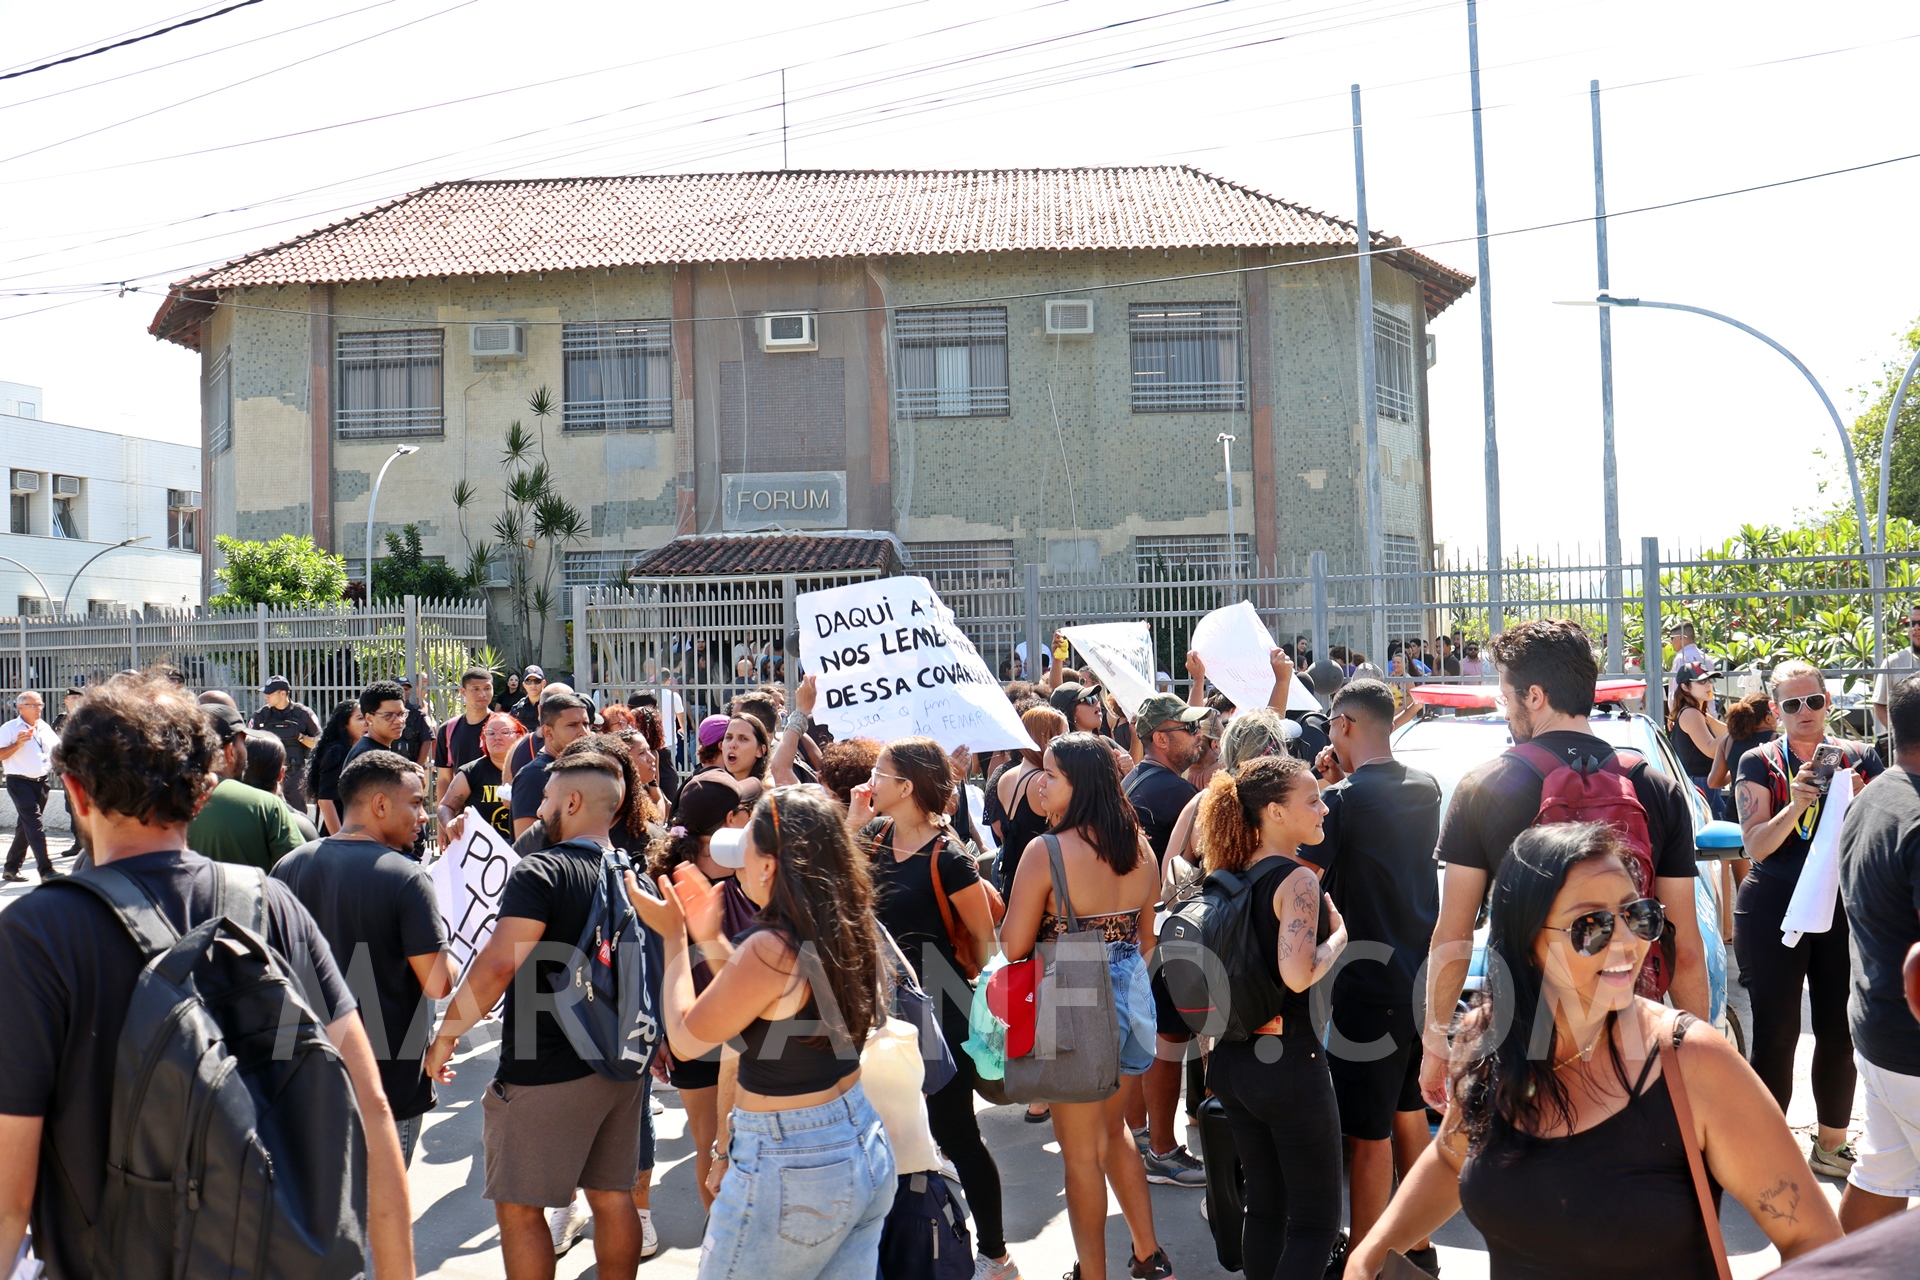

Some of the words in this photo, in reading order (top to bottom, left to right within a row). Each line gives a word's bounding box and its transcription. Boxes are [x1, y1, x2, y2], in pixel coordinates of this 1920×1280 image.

[738, 489, 829, 511] FORUM
[815, 596, 894, 638] DAQUI
[911, 599, 925, 617] A
[820, 643, 870, 674] NOS
[826, 677, 912, 709] DESSA
